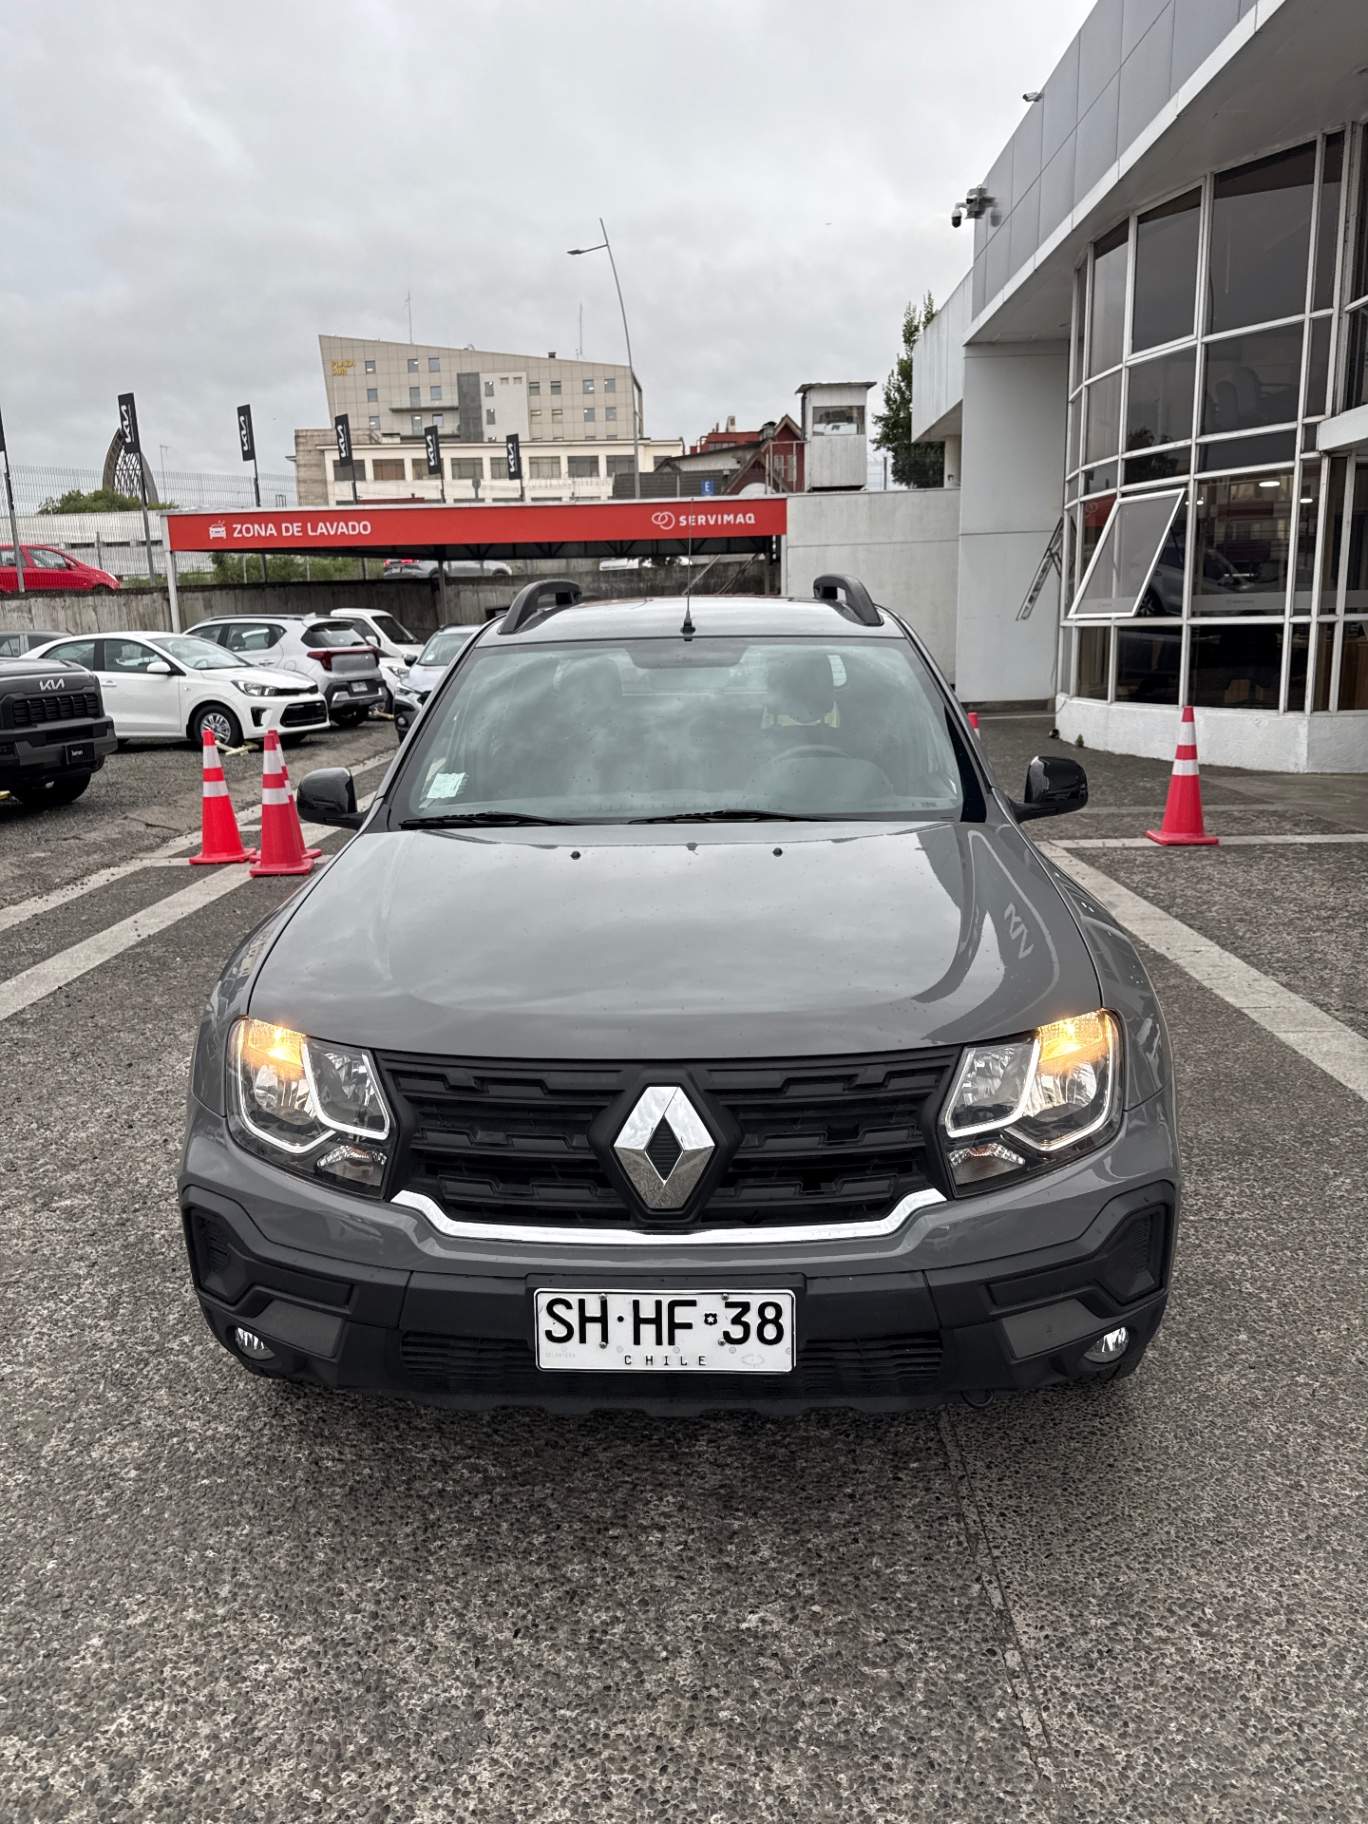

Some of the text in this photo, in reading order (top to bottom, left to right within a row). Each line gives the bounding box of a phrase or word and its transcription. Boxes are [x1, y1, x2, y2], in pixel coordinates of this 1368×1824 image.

[679, 513, 756, 527] SERVIMAQ
[232, 521, 372, 538] ZONA DE LAVADO
[39, 678, 65, 691] KIA
[624, 1354, 708, 1367] CHILE
